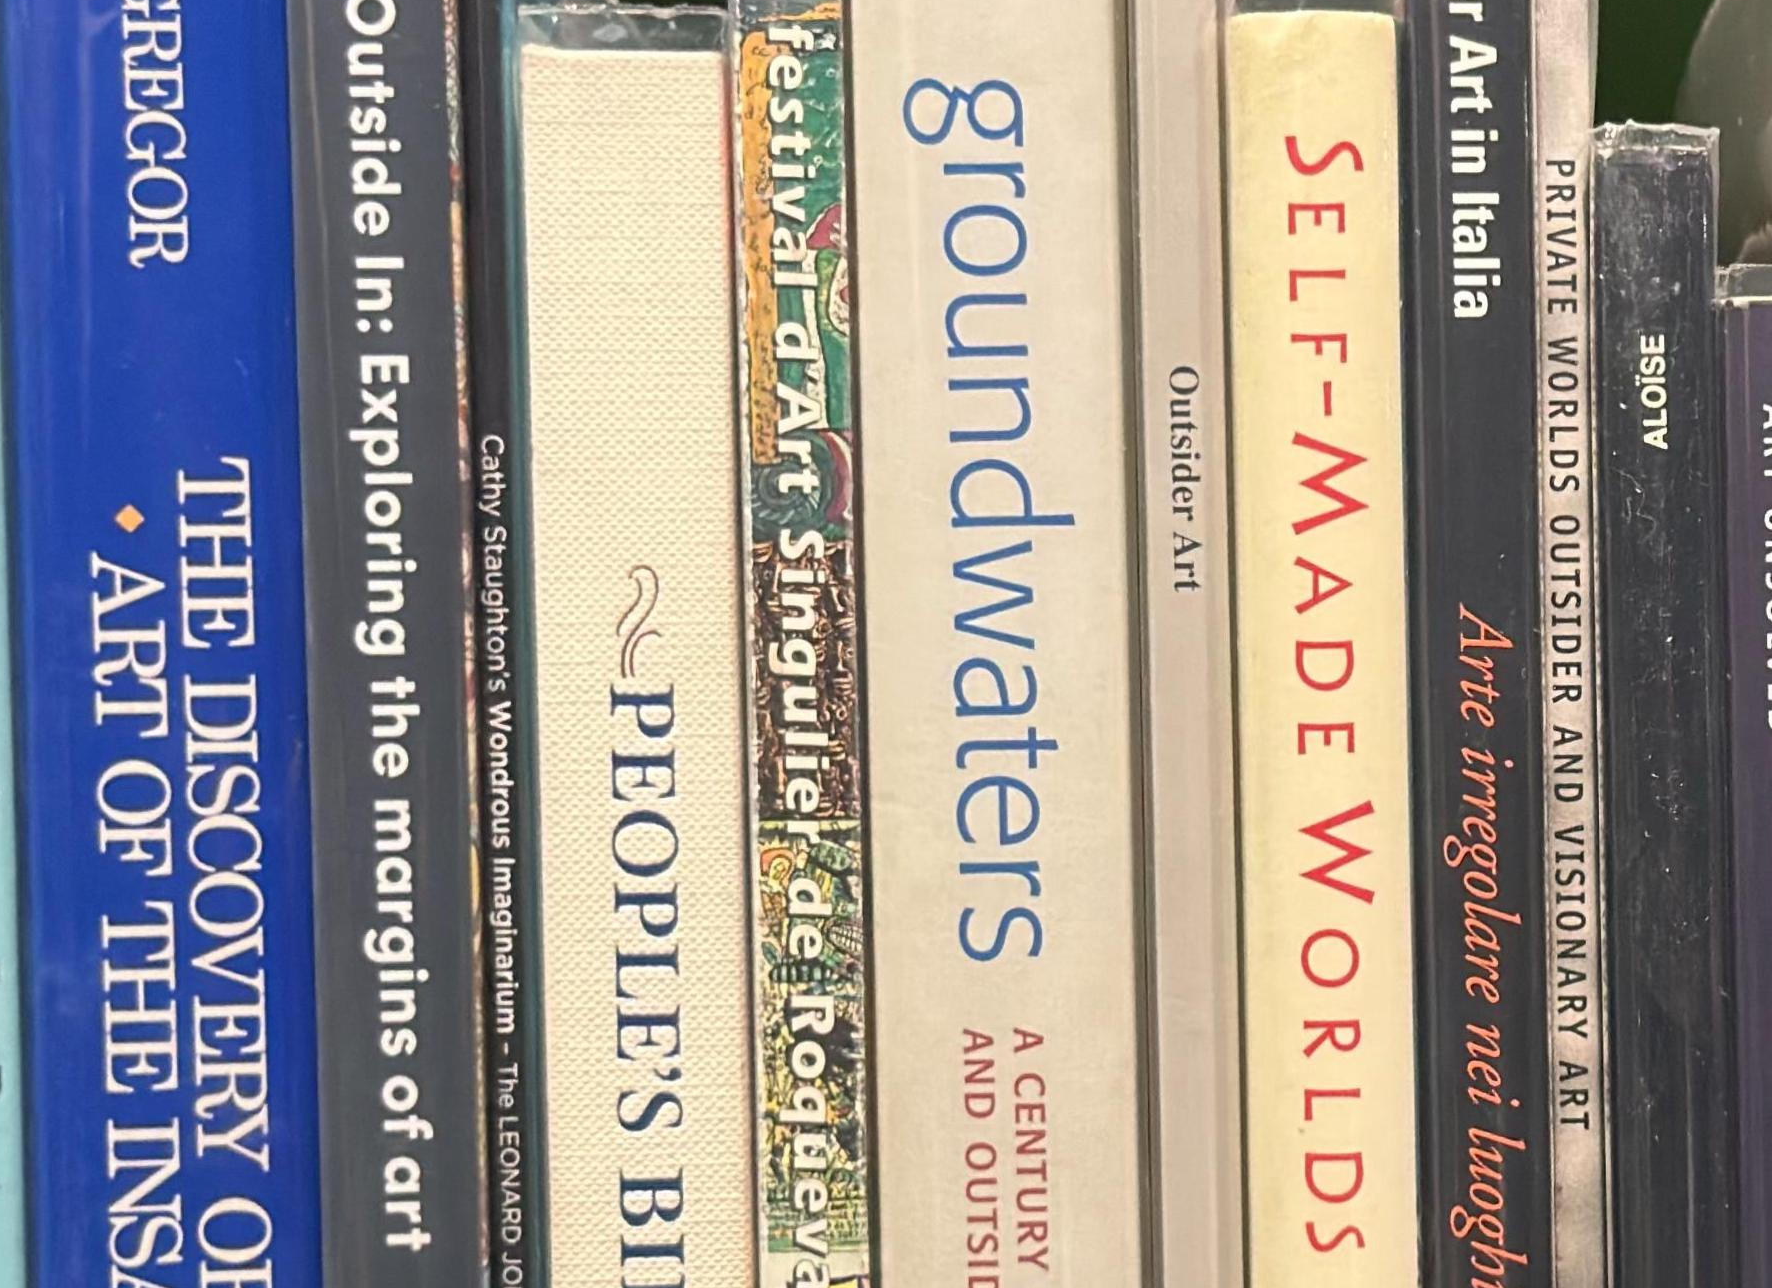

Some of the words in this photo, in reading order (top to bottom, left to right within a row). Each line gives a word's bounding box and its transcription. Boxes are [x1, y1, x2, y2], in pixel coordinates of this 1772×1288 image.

[1448, 37, 1494, 113] Art
[765, 24, 820, 286] festival
[1451, 130, 1501, 173] in
[354, 256, 405, 333] In:
[1451, 192, 1501, 318] Italia
[1546, 160, 1578, 315] PRIVATE
[1167, 365, 1202, 523] Outsider
[1547, 336, 1583, 494] WORLDS
[1638, 334, 1669, 450] ALOÏSE
[346, 353, 415, 658] Exploring
[475, 434, 506, 518] Cathy
[902, 77, 1076, 963] groundwaters
[176, 456, 256, 649] THE
[479, 526, 511, 692] Staughton's
[1172, 531, 1205, 593] Art
[1551, 514, 1584, 705] OUTSIDER
[369, 676, 421, 778] the
[761, 527, 833, 847] Singulier
[1458, 602, 1515, 723] Arte
[487, 701, 516, 849] Wondrous
[1554, 725, 1584, 804] AND
[182, 675, 269, 1171] DISCOVERY
[362, 798, 429, 1056] margins
[489, 857, 518, 1033] Imaginarium
[609, 684, 684, 1133] PEOPLE'S
[786, 876, 837, 958] de
[1443, 747, 1520, 999] irregolare
[1554, 825, 1589, 1040] VISIONARY
[496, 1062, 520, 1109] The
[1299, 799, 1378, 1256] WORLDS
[1465, 1023, 1525, 1107] nei
[1558, 1061, 1590, 1131] ART
[381, 1073, 434, 1141] of
[496, 1117, 525, 1244] LEONARD
[386, 1158, 436, 1251] art
